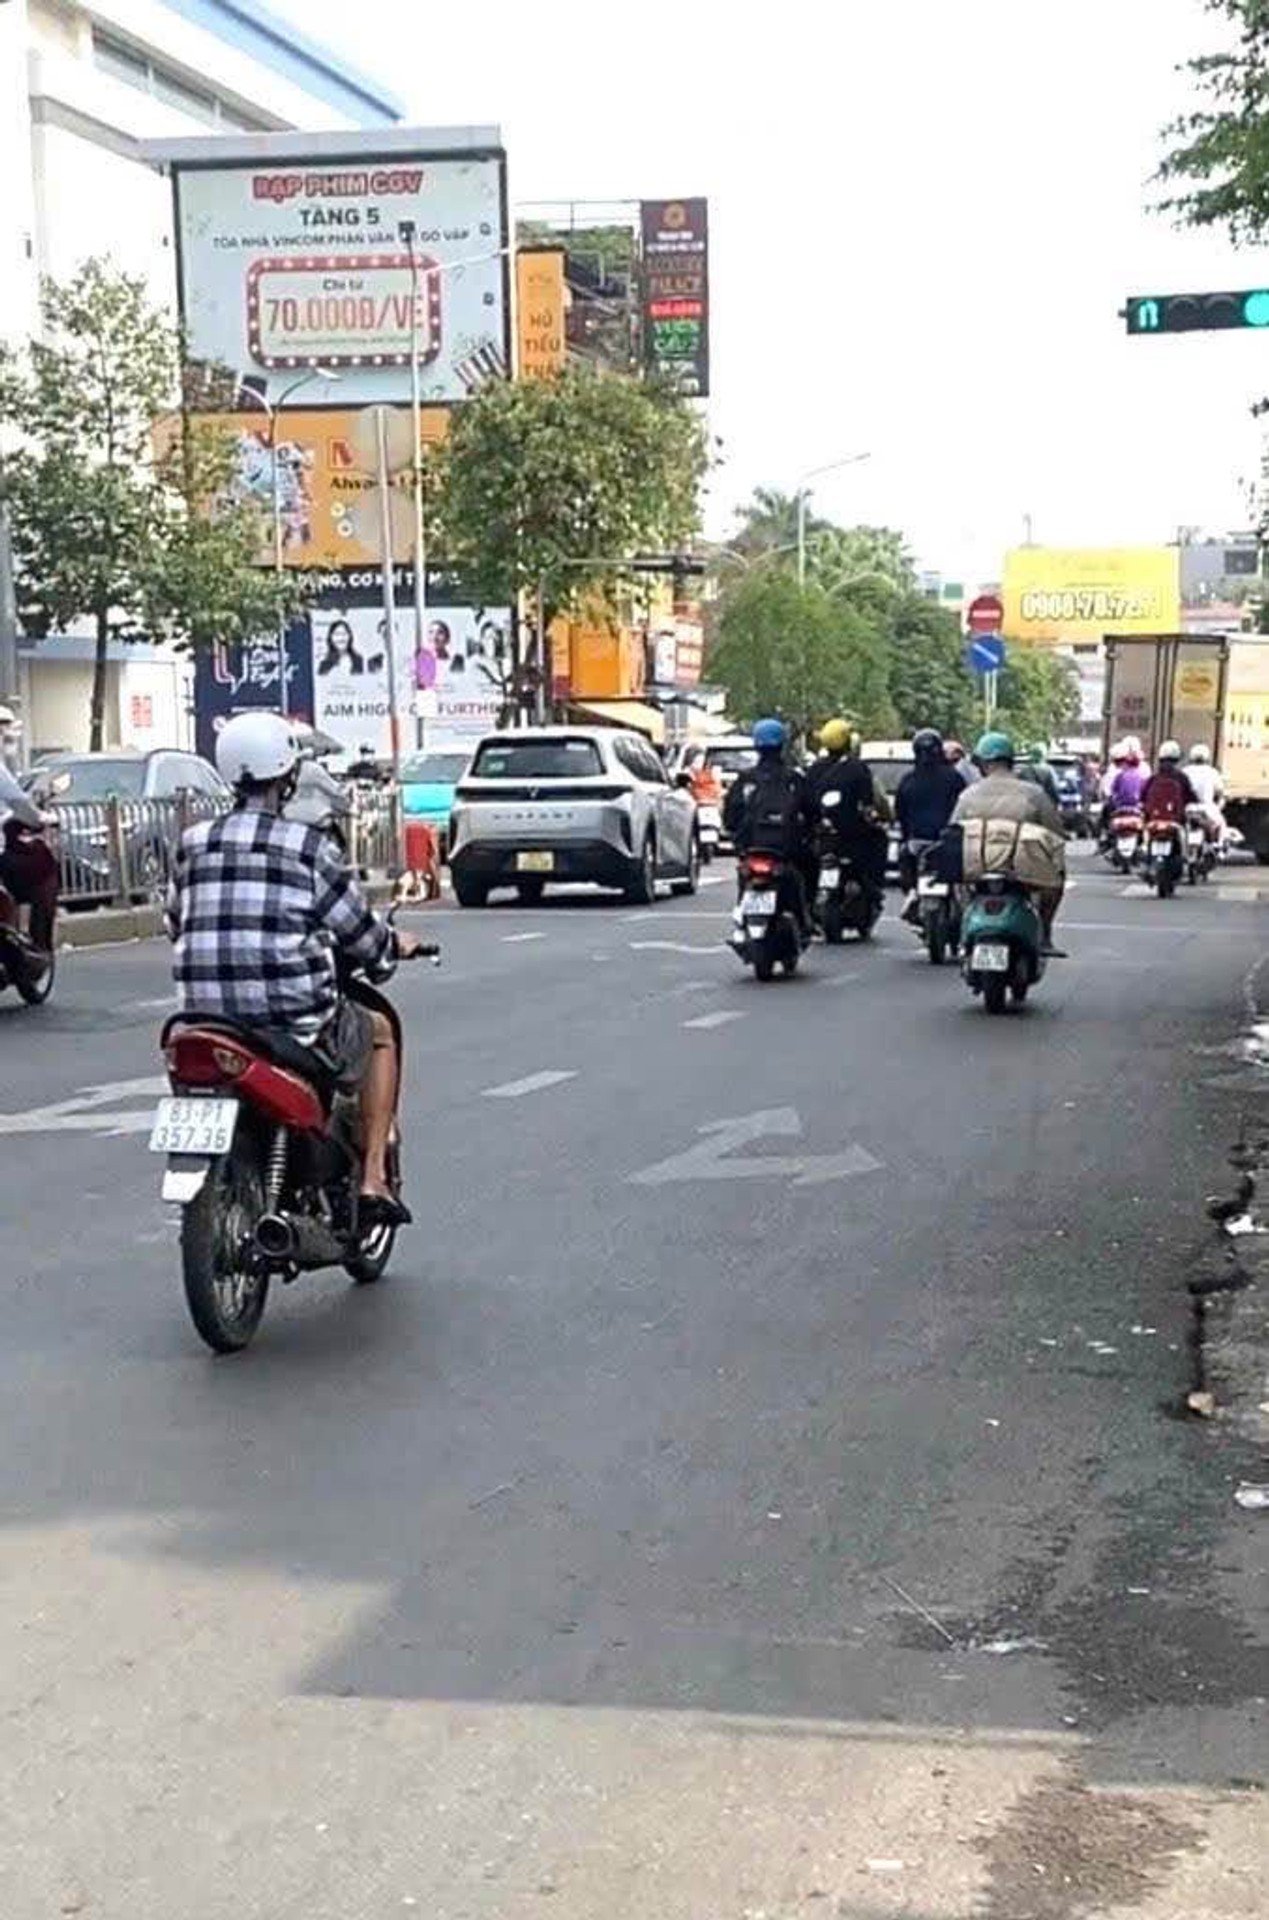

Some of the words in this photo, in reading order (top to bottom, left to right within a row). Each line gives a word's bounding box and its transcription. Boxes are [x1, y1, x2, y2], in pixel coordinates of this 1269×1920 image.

[253, 175, 302, 204] RẠP
[305, 172, 369, 197] PHIM
[366, 206, 381, 225] 5
[324, 701, 353, 717] AIM
[357, 701, 391, 717] HIG
